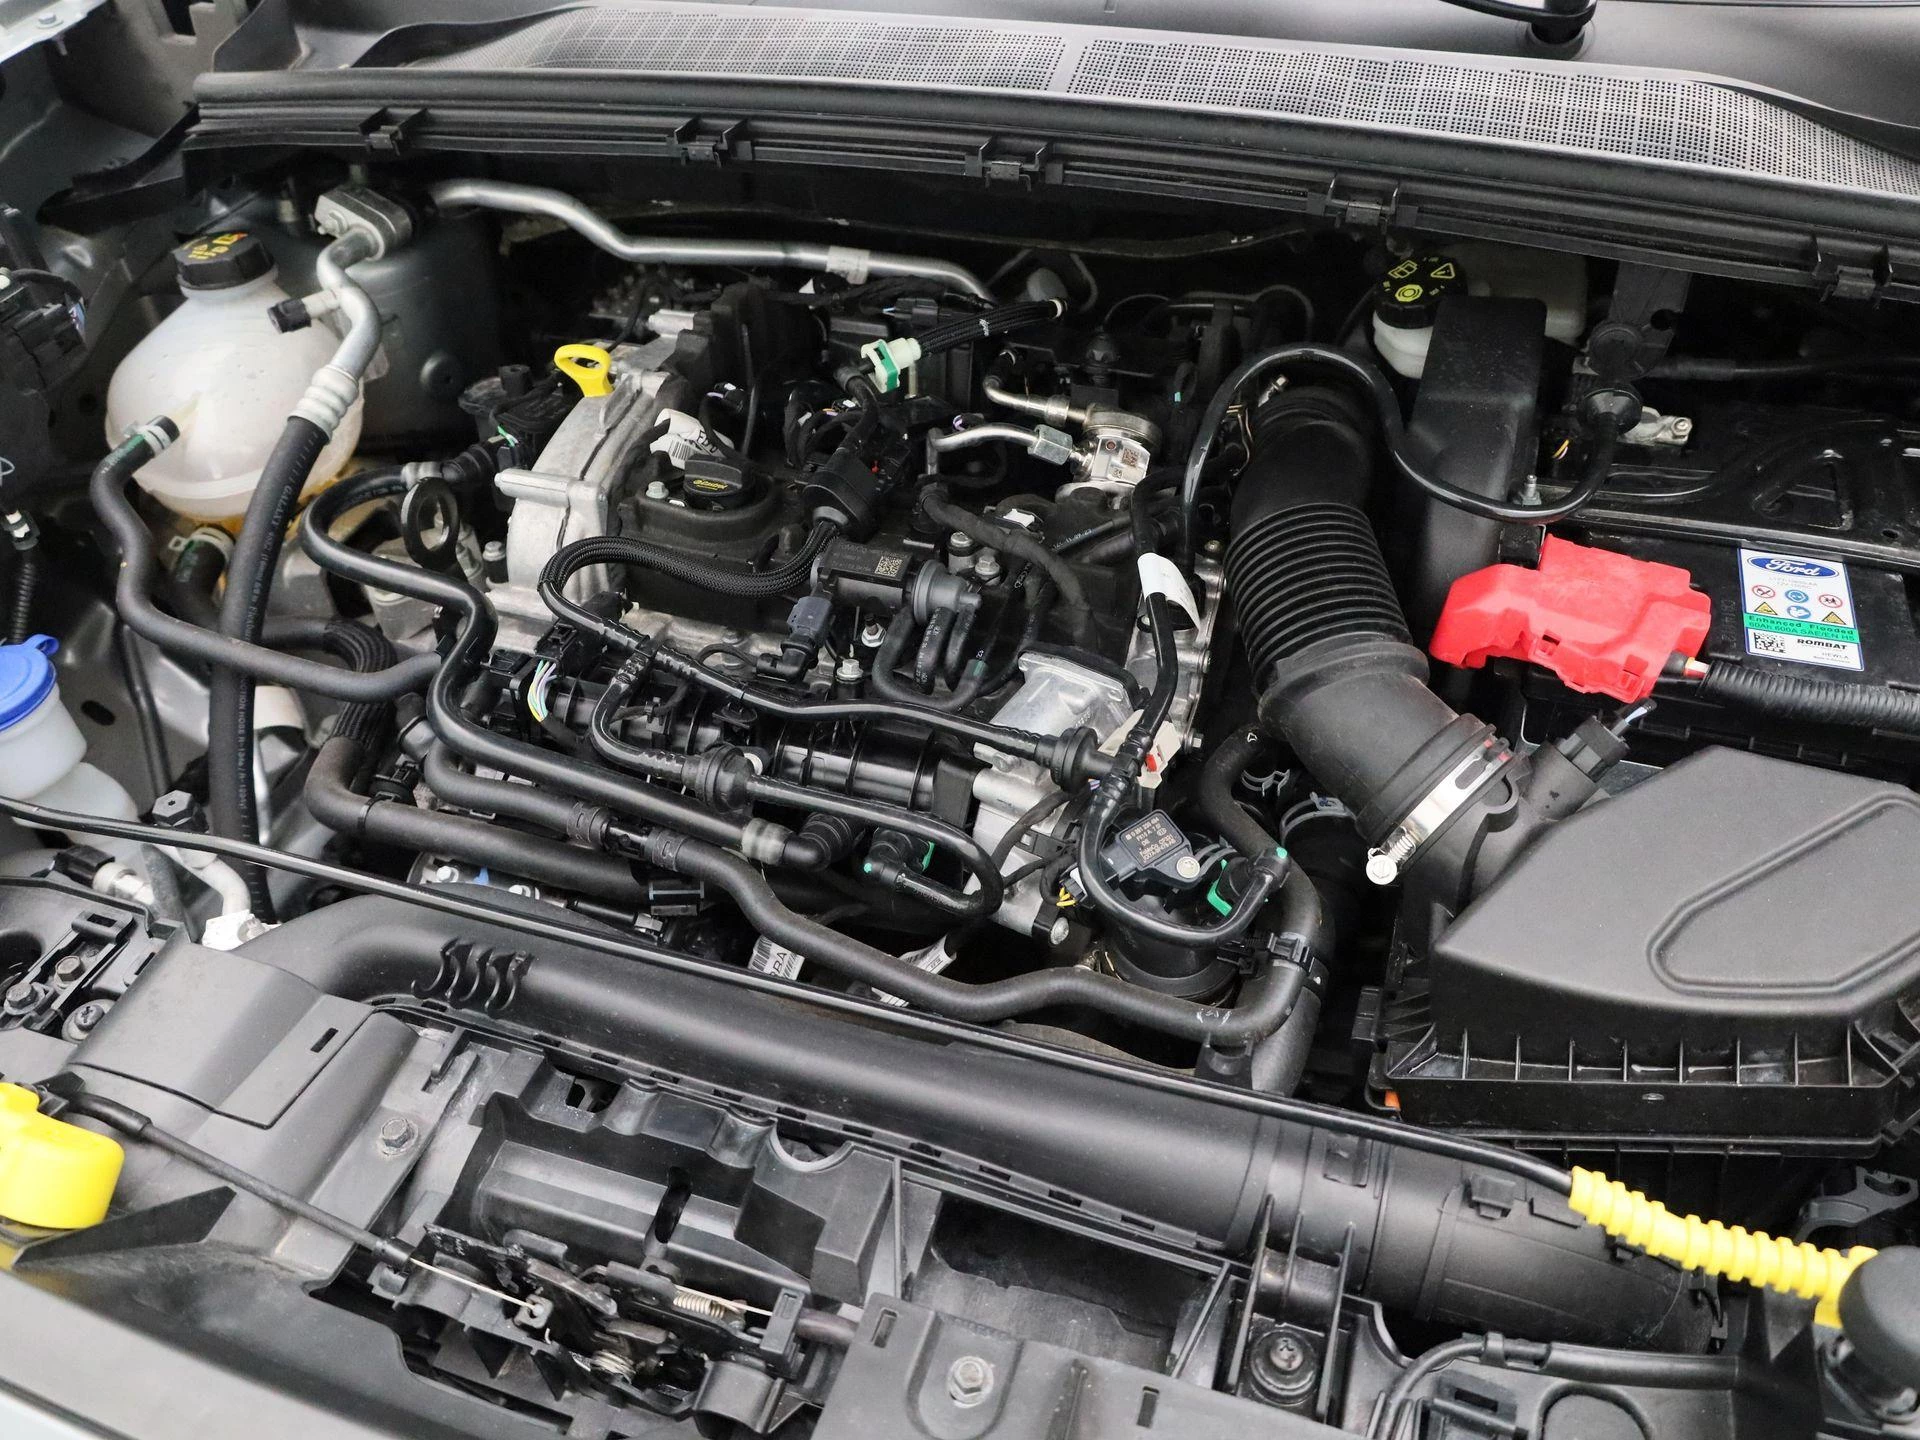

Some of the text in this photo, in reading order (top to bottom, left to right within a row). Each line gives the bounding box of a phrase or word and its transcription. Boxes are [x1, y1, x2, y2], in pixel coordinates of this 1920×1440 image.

[1765, 558, 1820, 576] Ford
[1748, 614, 1854, 636] Enhanced Flooded
[1796, 637, 1848, 651] ROMBAT
